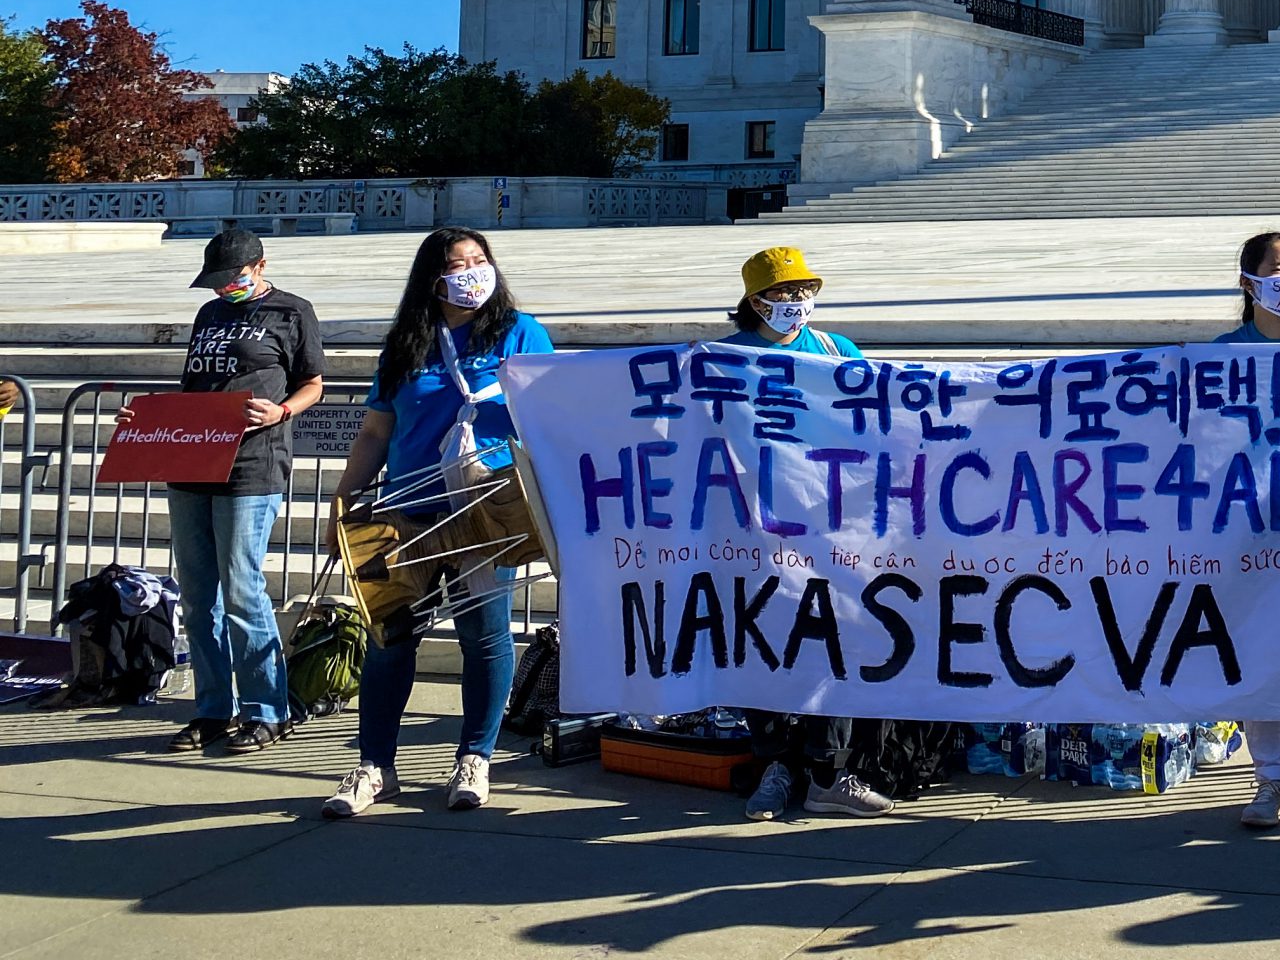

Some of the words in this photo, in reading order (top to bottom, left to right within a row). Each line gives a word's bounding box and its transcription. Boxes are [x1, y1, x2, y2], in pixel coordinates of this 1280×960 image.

[629, 349, 812, 443] 모두를
[831, 358, 972, 442] 위한
[301, 409, 351, 419] PROPERTY
[354, 410, 368, 419] OF
[297, 420, 331, 430] UNITED
[336, 421, 364, 430] STATE
[117, 427, 239, 443] #HealthCareVoter
[292, 430, 338, 440] SUPREME
[315, 442, 350, 452] POLICE
[709, 538, 761, 572] công
[773, 541, 815, 568] dân
[1060, 738, 1089, 754] DEER
[1060, 749, 1089, 766] PARK
